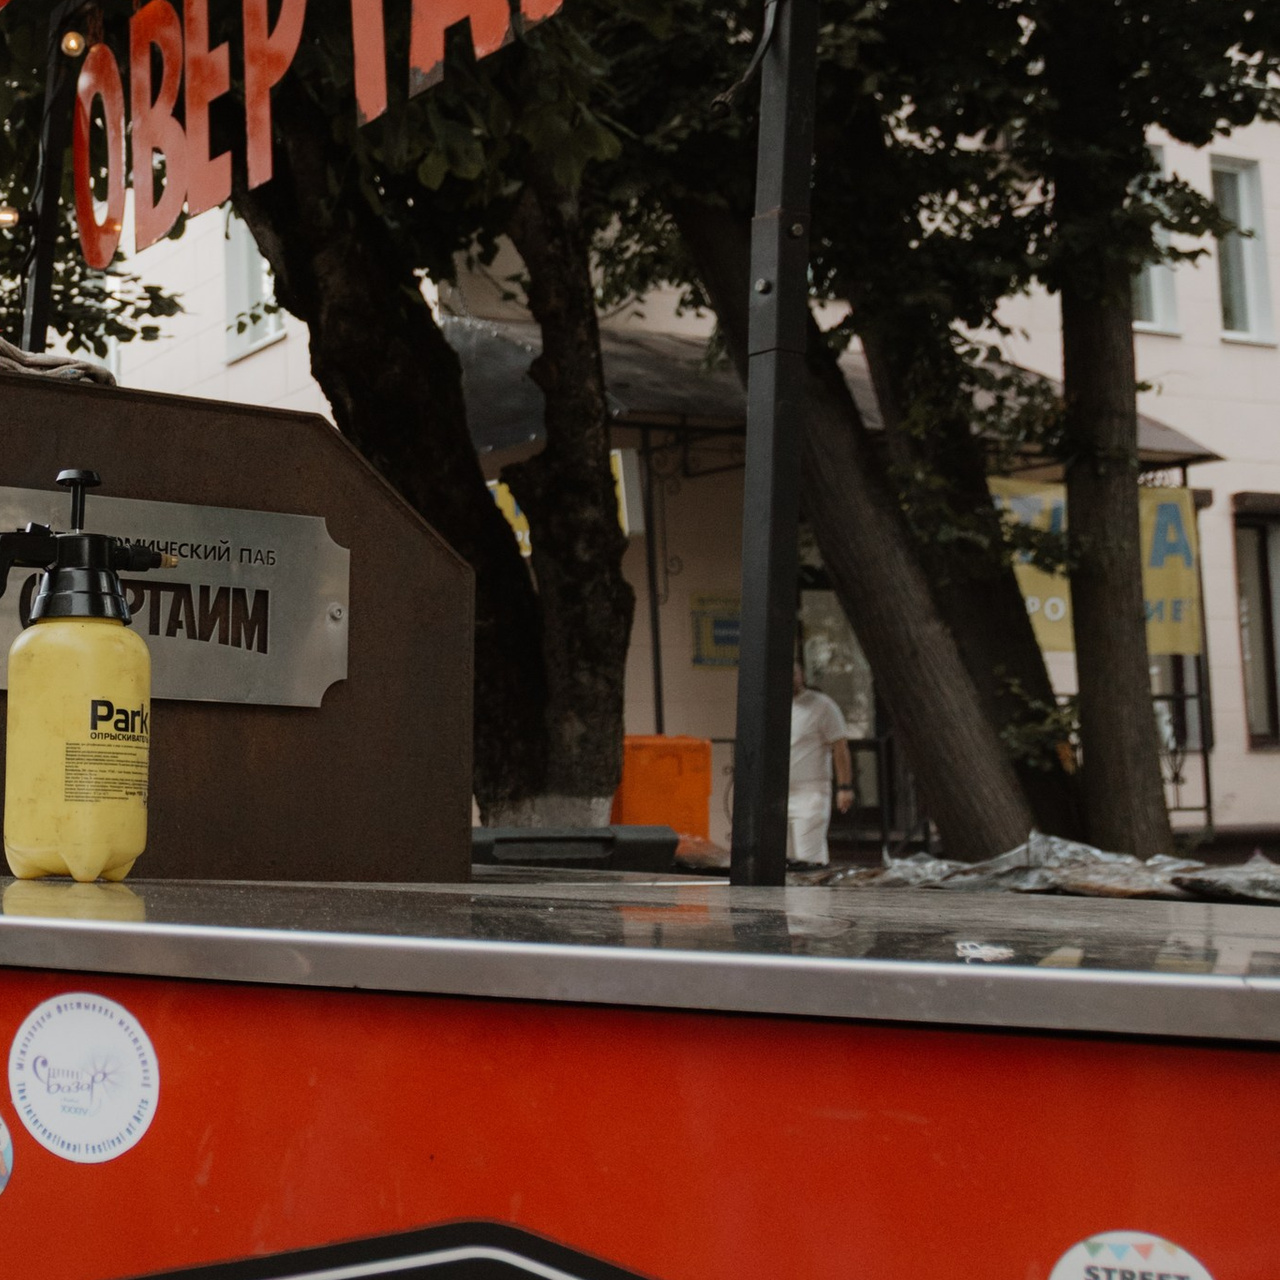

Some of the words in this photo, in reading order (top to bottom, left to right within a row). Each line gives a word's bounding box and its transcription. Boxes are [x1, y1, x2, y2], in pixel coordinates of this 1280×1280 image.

[239, 547, 277, 566] ПАБ
[90, 699, 149, 735] Park
[85, 1132, 126, 1155] Festival
